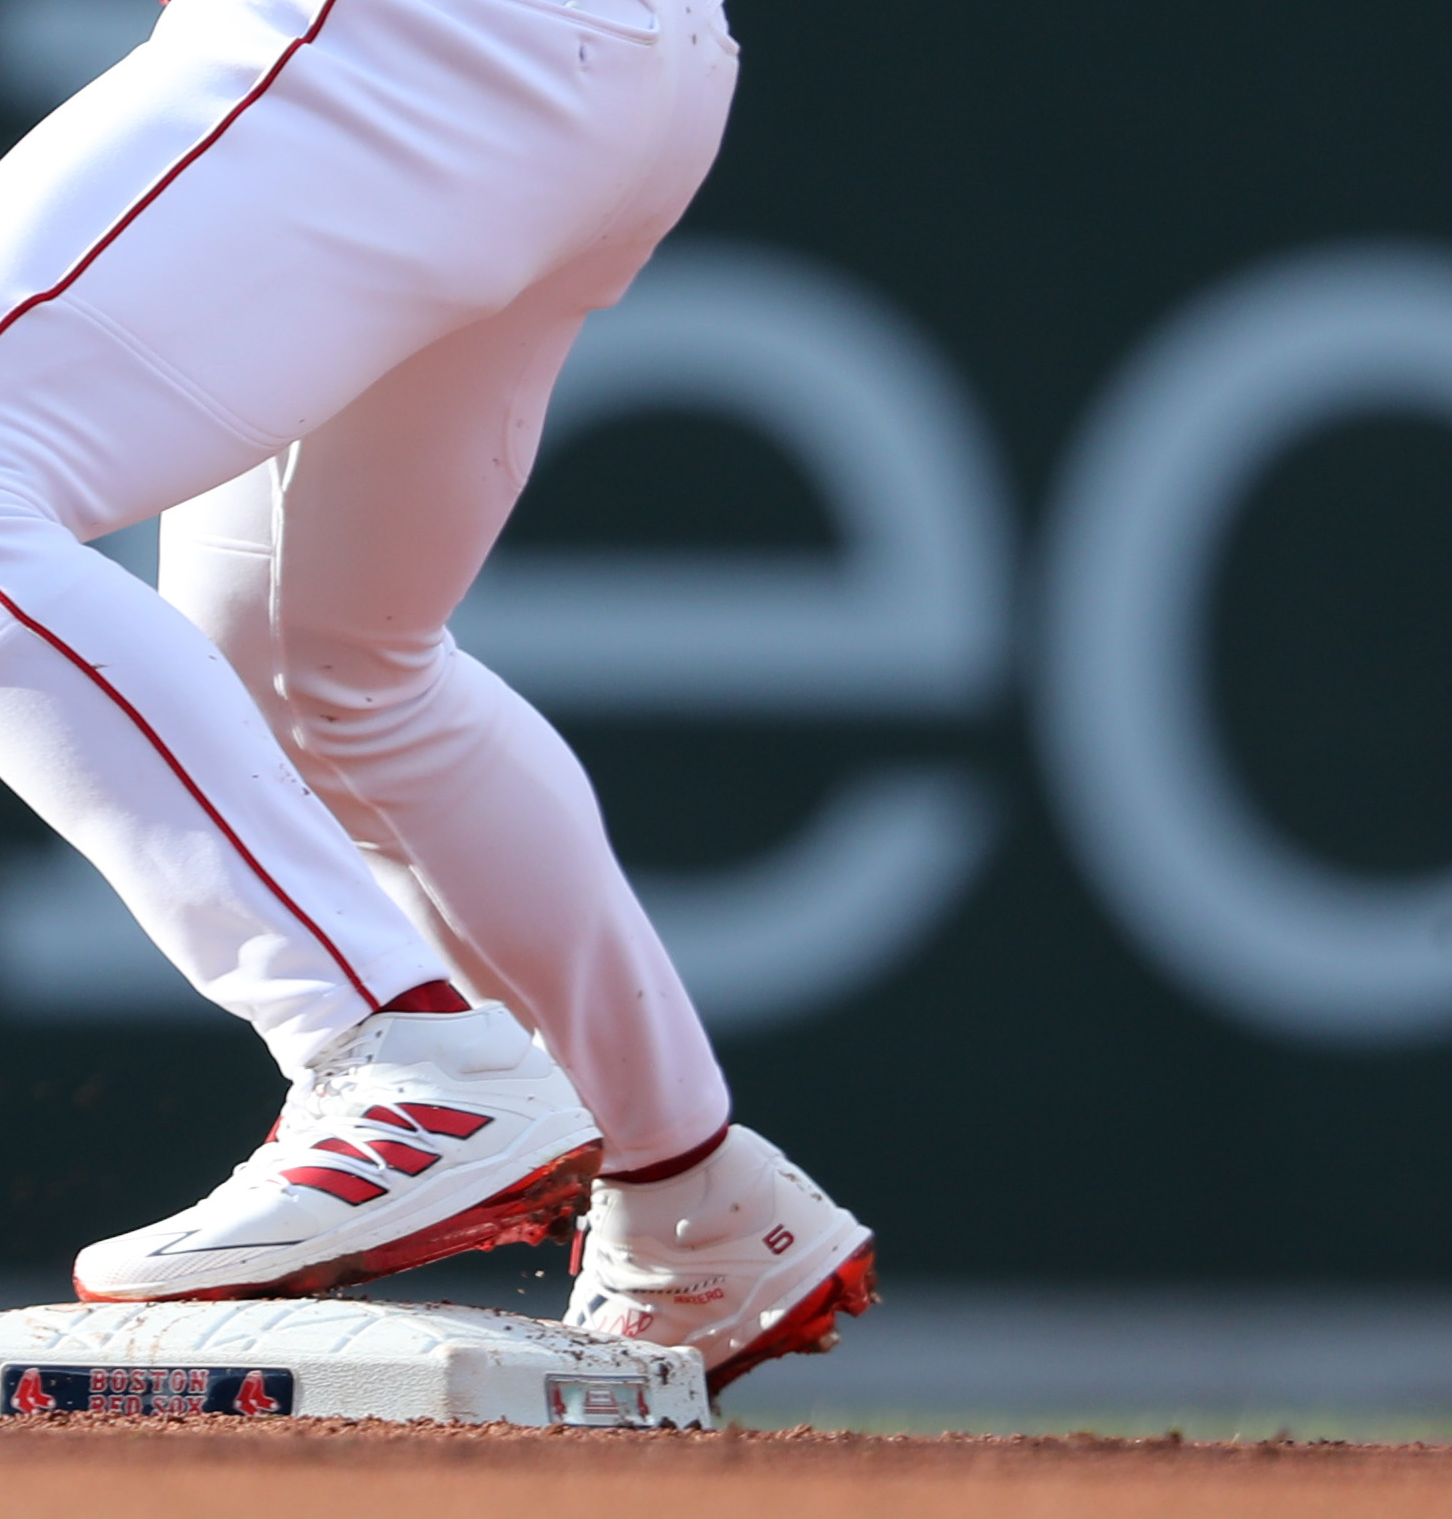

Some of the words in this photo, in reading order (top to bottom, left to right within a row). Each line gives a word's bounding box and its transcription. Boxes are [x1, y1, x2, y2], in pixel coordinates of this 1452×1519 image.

[762, 1223, 795, 1256] 5
[89, 1368, 209, 1393] BOSTON
[88, 1394, 142, 1416] RED
[149, 1395, 208, 1416] SOX
